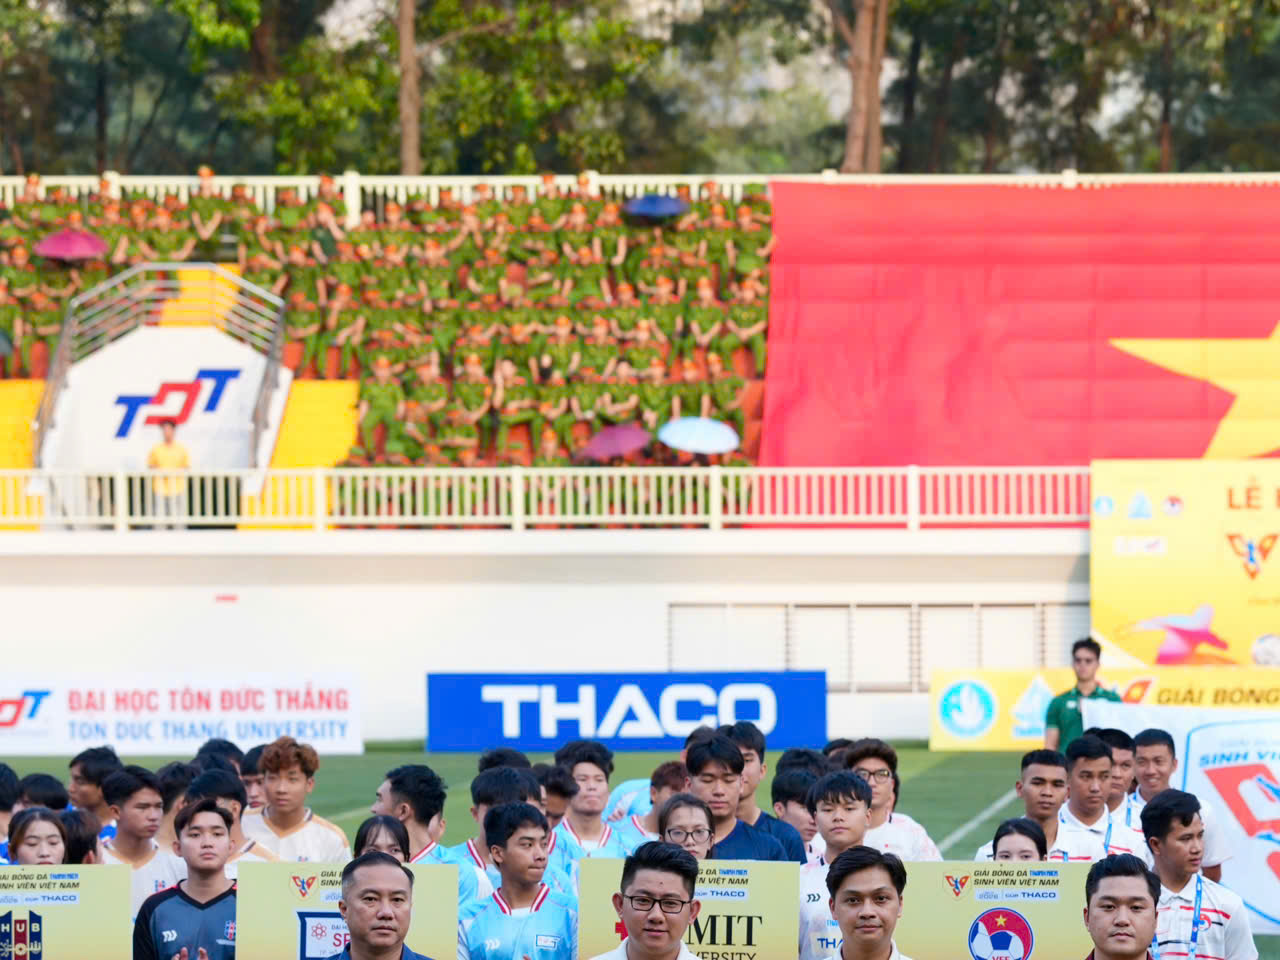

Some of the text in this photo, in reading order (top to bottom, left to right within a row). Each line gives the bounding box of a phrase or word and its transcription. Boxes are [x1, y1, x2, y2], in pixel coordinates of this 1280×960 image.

[68, 681, 349, 715] ĐẠI HỌC TÔN ĐỨC THẮNG
[482, 683, 777, 738] THACO
[69, 720, 349, 741] TON DUC THANG UNIVERSITY
[1200, 751, 1249, 766] SINH
[997, 878, 1017, 886] VIÊN
[1020, 878, 1037, 887] VIỆT
[710, 890, 745, 898] THACO
[685, 914, 763, 947] MIT
